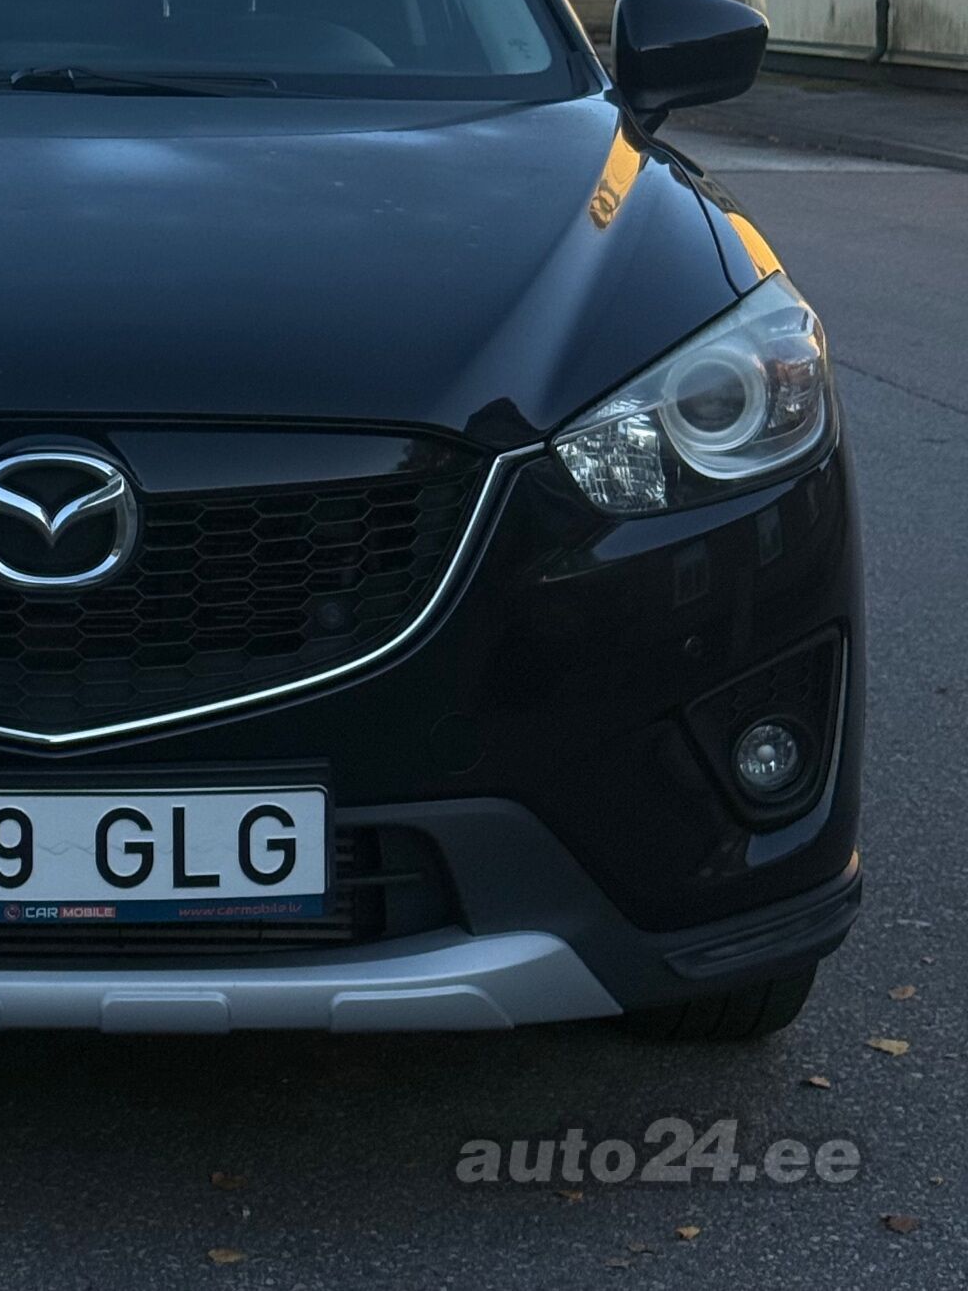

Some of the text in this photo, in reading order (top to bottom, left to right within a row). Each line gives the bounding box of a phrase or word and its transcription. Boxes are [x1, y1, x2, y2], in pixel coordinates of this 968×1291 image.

[95, 804, 297, 889] GLG
[25, 907, 114, 918] CAR MOBILE
